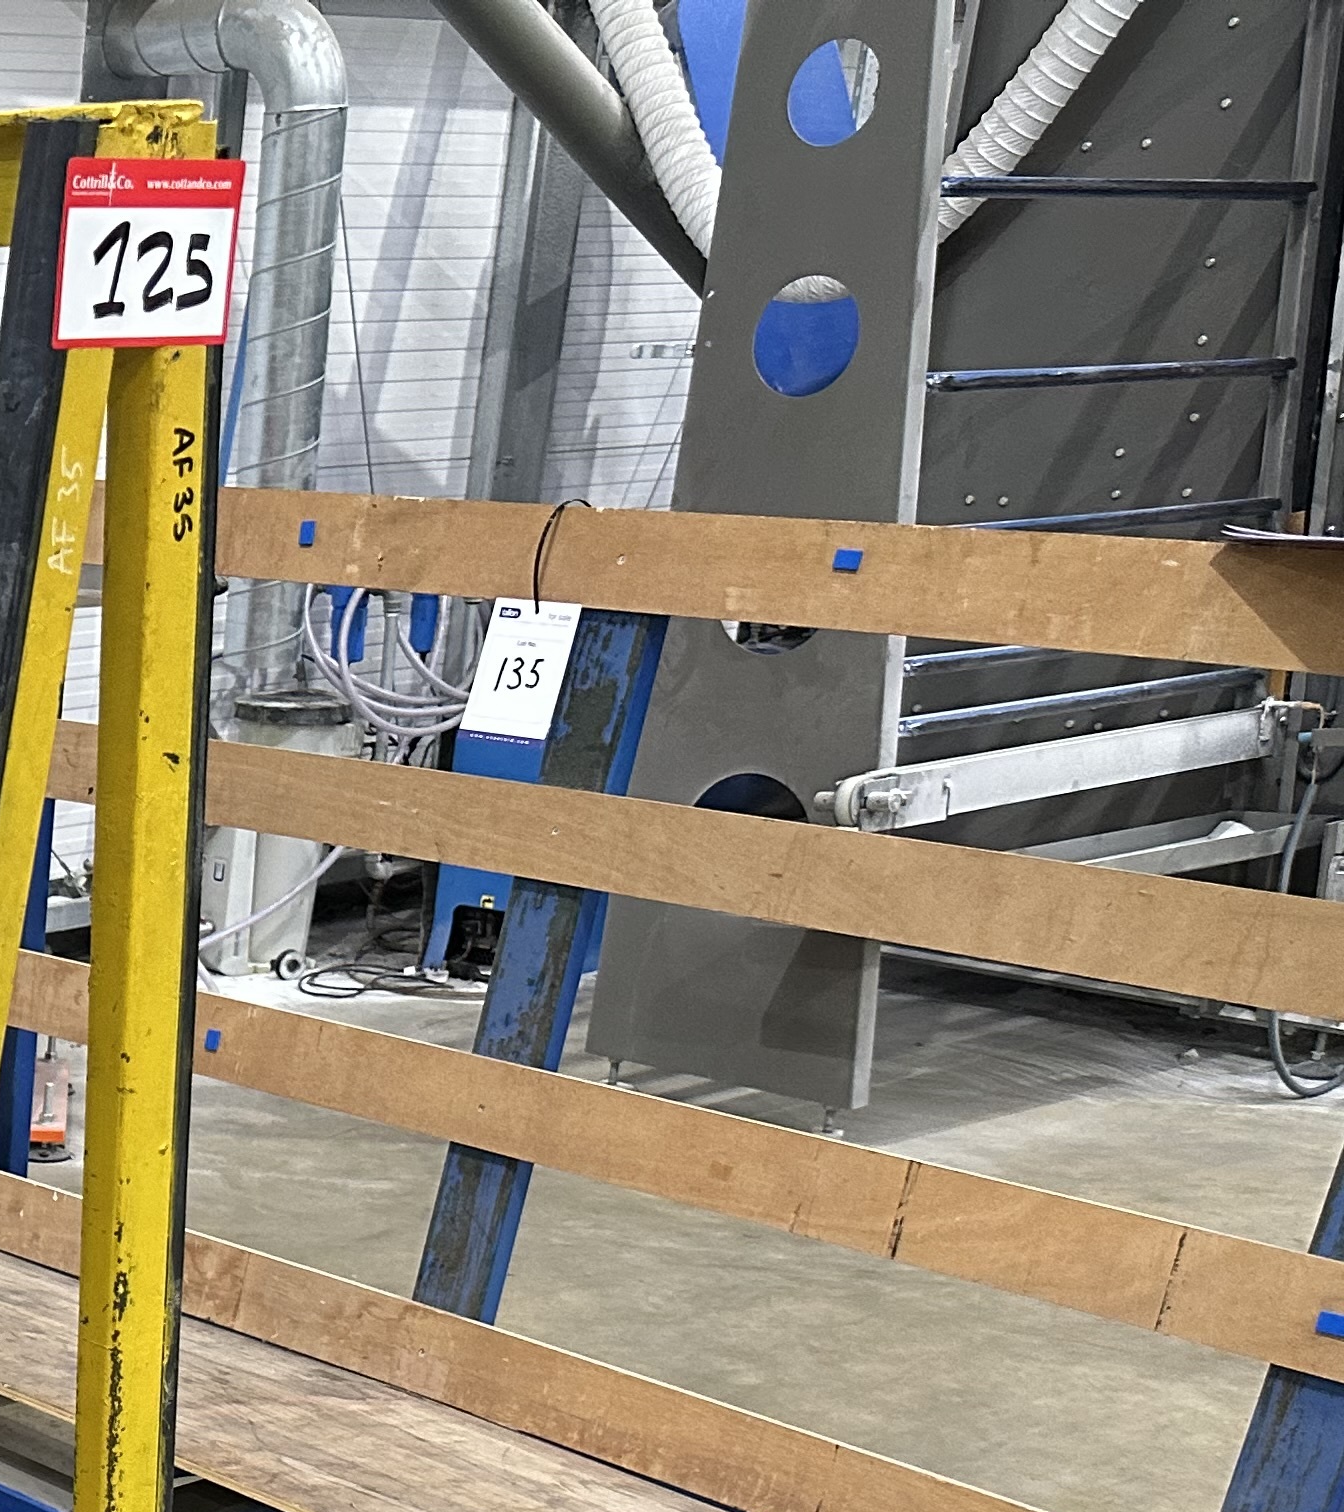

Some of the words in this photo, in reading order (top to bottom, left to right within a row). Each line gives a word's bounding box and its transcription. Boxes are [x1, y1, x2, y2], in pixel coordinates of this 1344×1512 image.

[93, 221, 213, 319] 125
[57, 444, 83, 502] 35
[173, 428, 195, 478] AF
[47, 516, 75, 575] AF
[494, 657, 545, 691] 135
